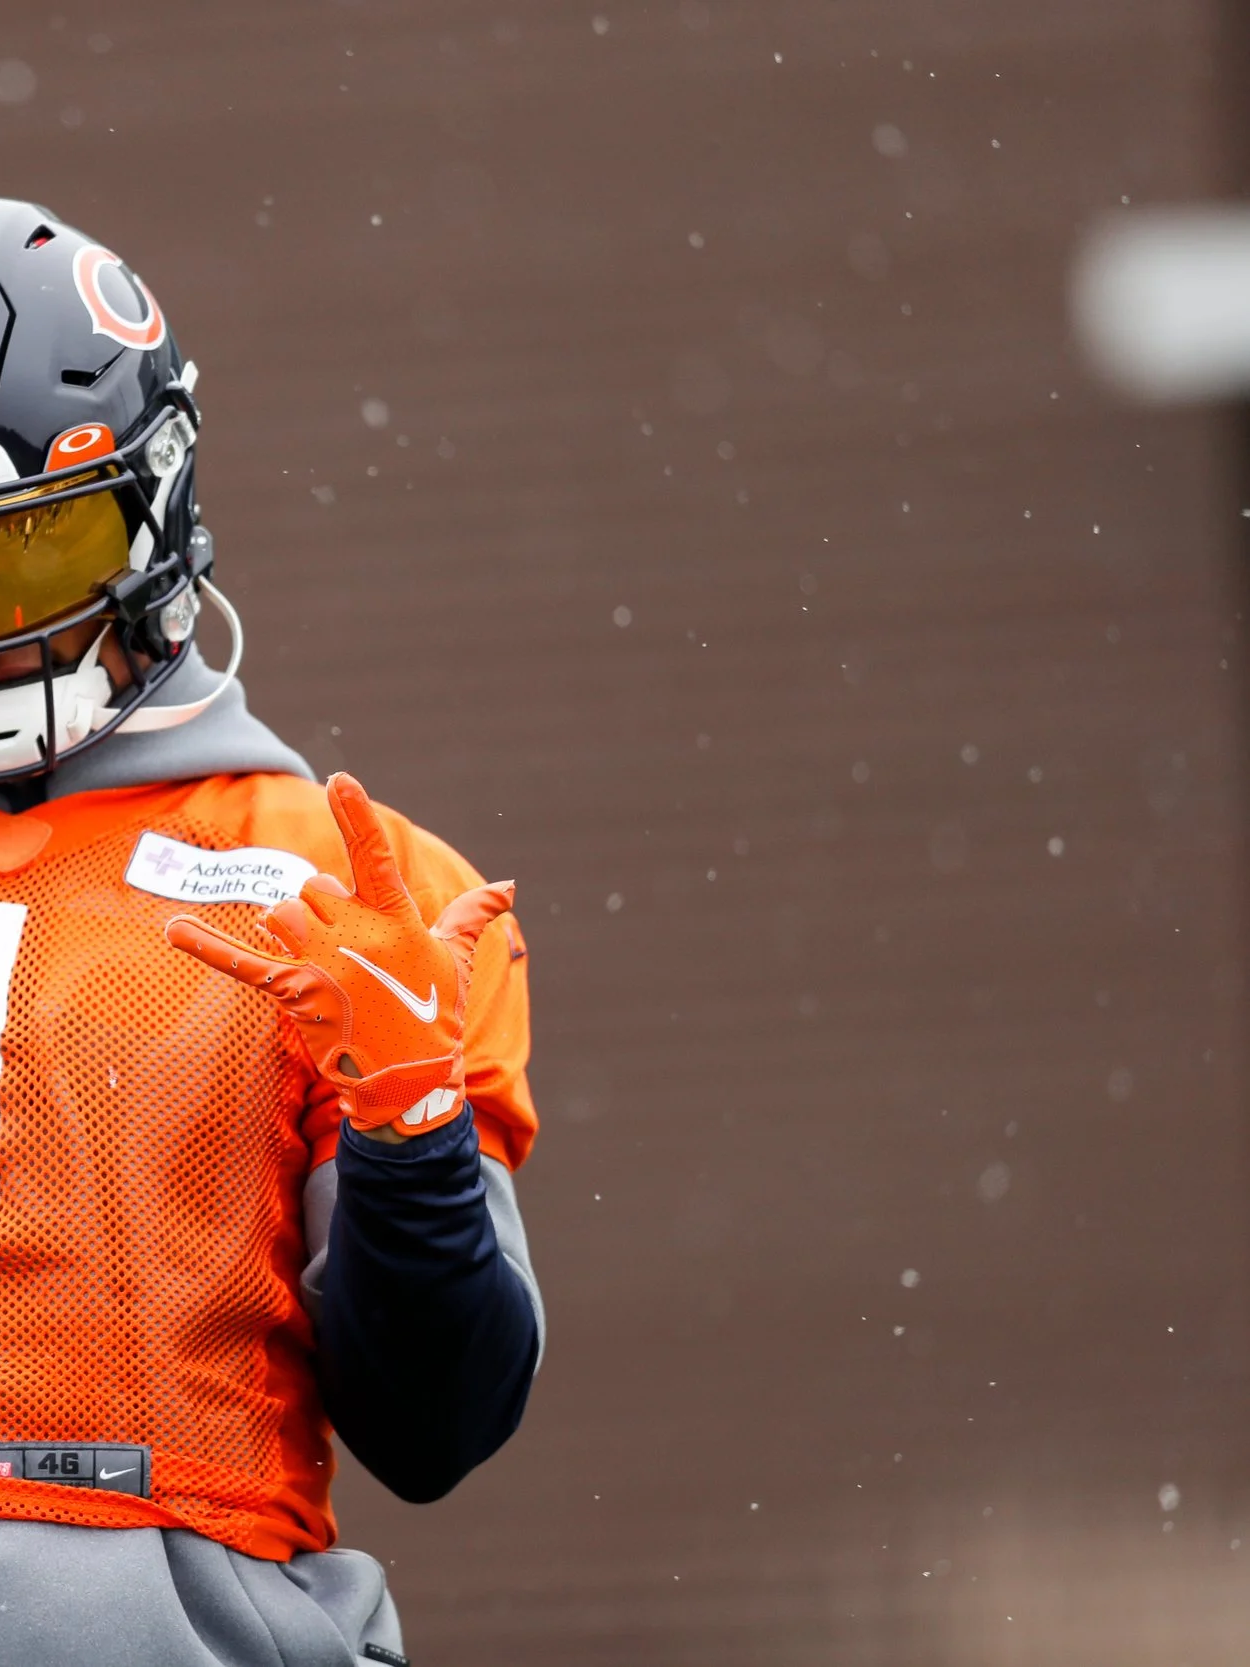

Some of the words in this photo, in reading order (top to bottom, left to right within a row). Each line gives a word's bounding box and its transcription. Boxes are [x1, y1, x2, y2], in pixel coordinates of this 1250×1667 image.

[187, 862, 283, 880] Advocate
[180, 879, 245, 895] Health
[252, 880, 297, 900] Car
[38, 1452, 79, 1475] 46
